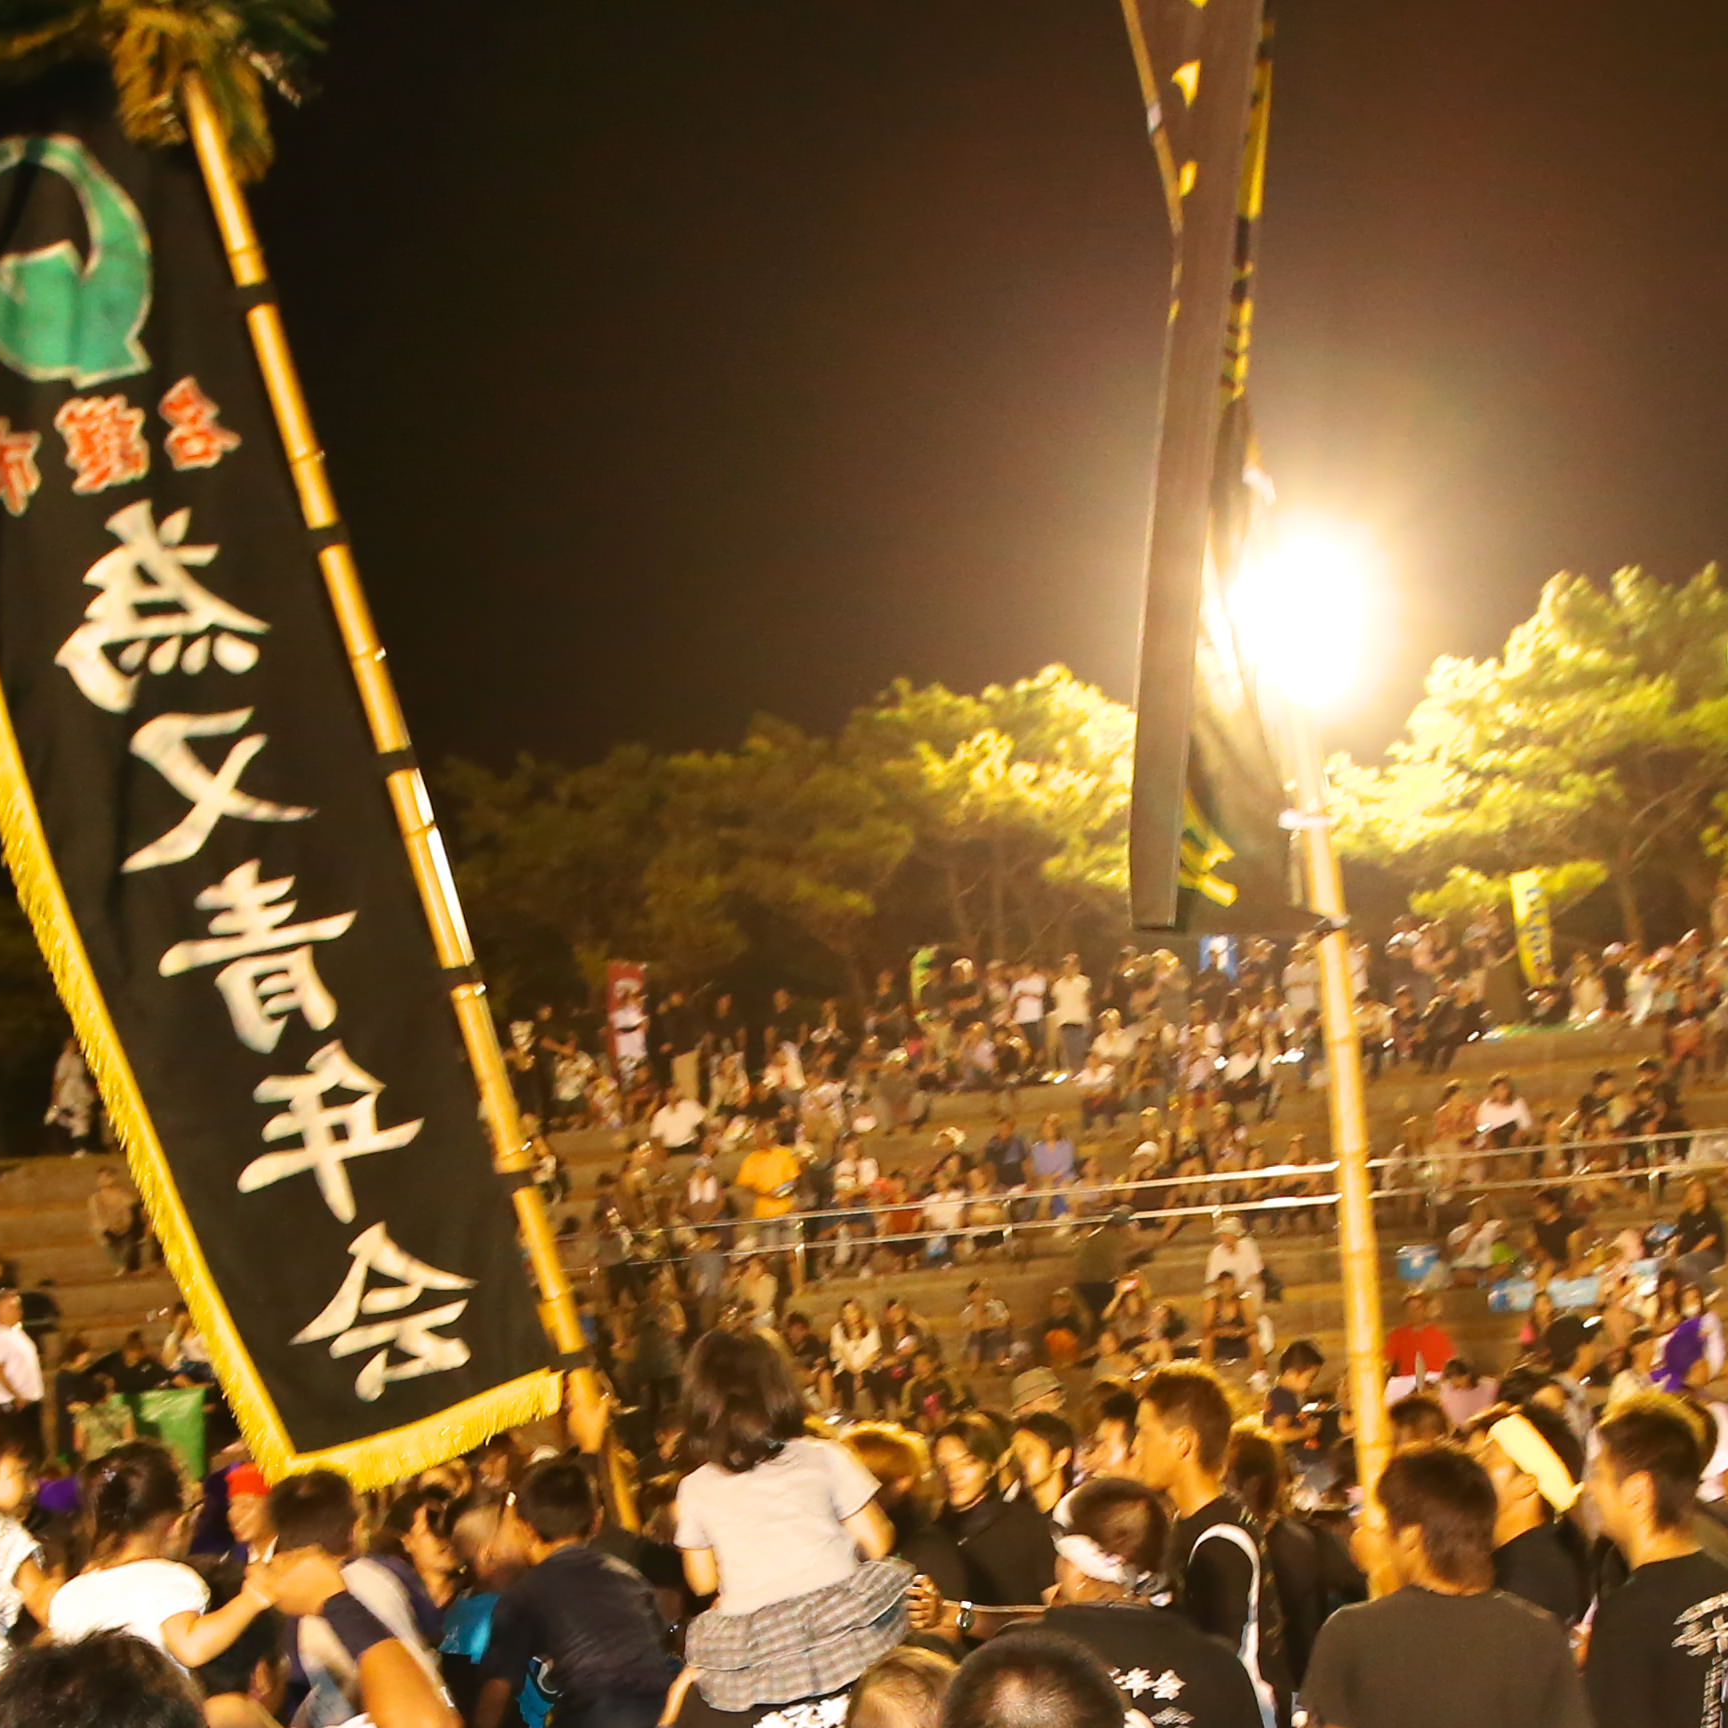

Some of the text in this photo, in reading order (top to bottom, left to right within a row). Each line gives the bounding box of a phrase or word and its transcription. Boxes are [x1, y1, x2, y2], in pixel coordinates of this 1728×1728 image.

[53, 498, 475, 1401] 為又青年会
